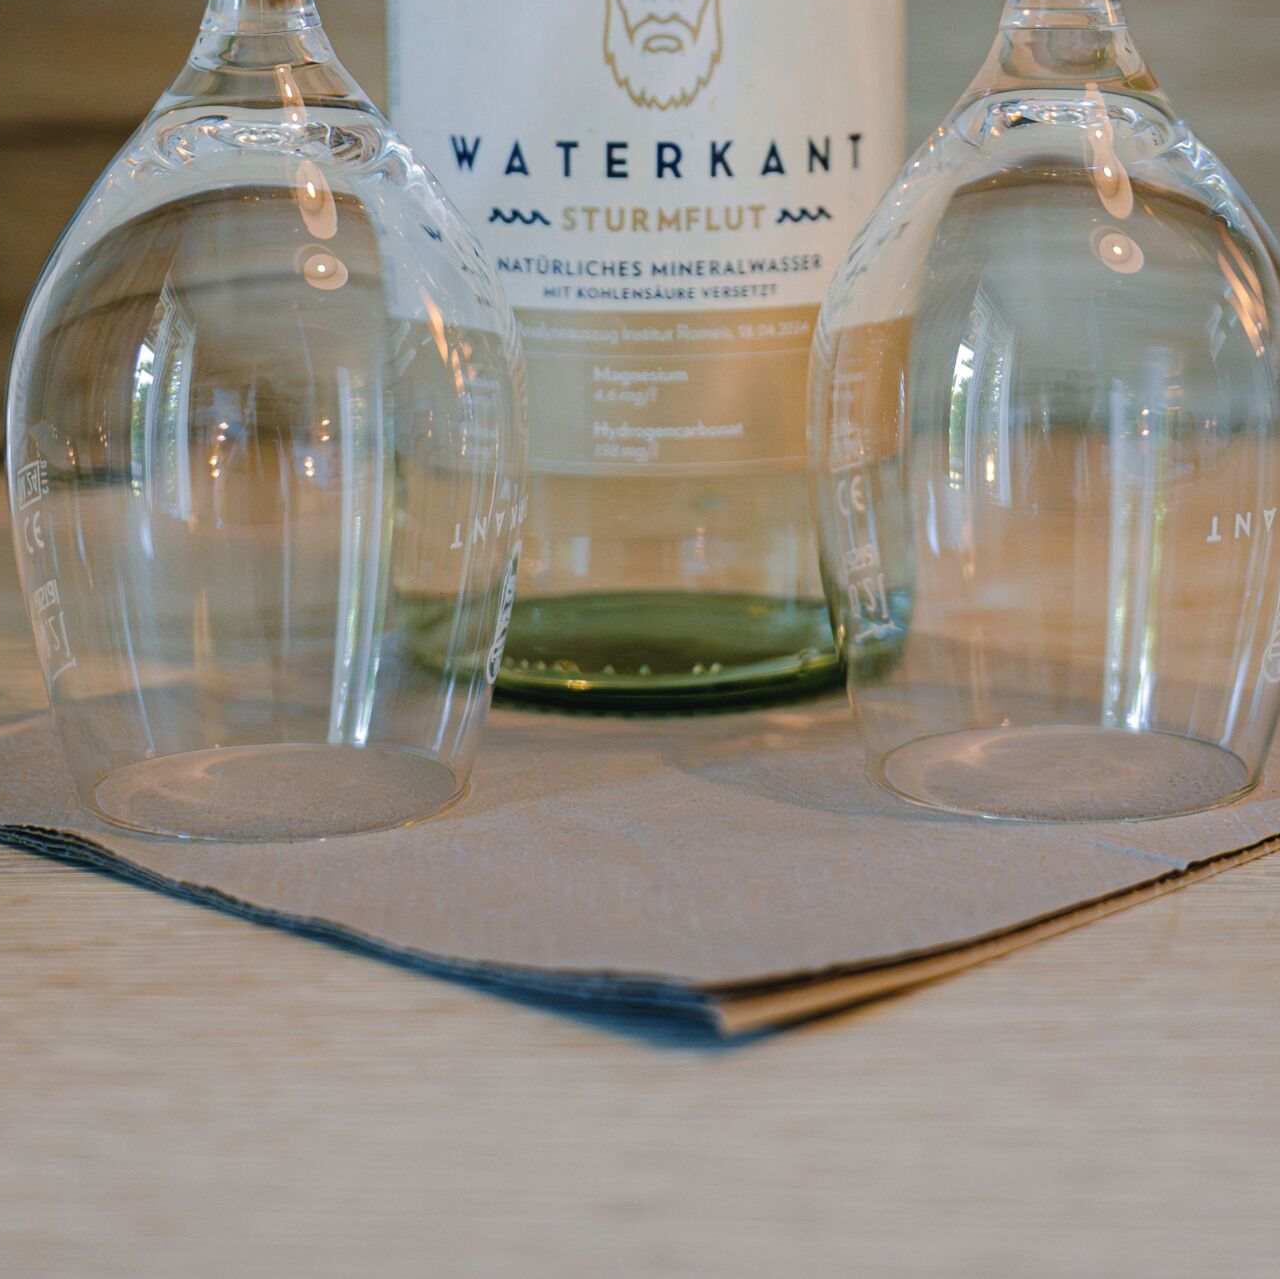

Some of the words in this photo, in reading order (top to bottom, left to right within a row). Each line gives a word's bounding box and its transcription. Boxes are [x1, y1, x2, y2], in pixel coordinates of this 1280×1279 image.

[450, 132, 862, 180] WATERKANT
[562, 204, 766, 233] STURMFLUT
[498, 255, 642, 278] NATÜRLICHES
[651, 253, 822, 277] MINERALWASSER
[544, 285, 570, 298] MIT
[577, 283, 695, 300] KOHLENSÄURE
[701, 283, 778, 299] VERSETZT
